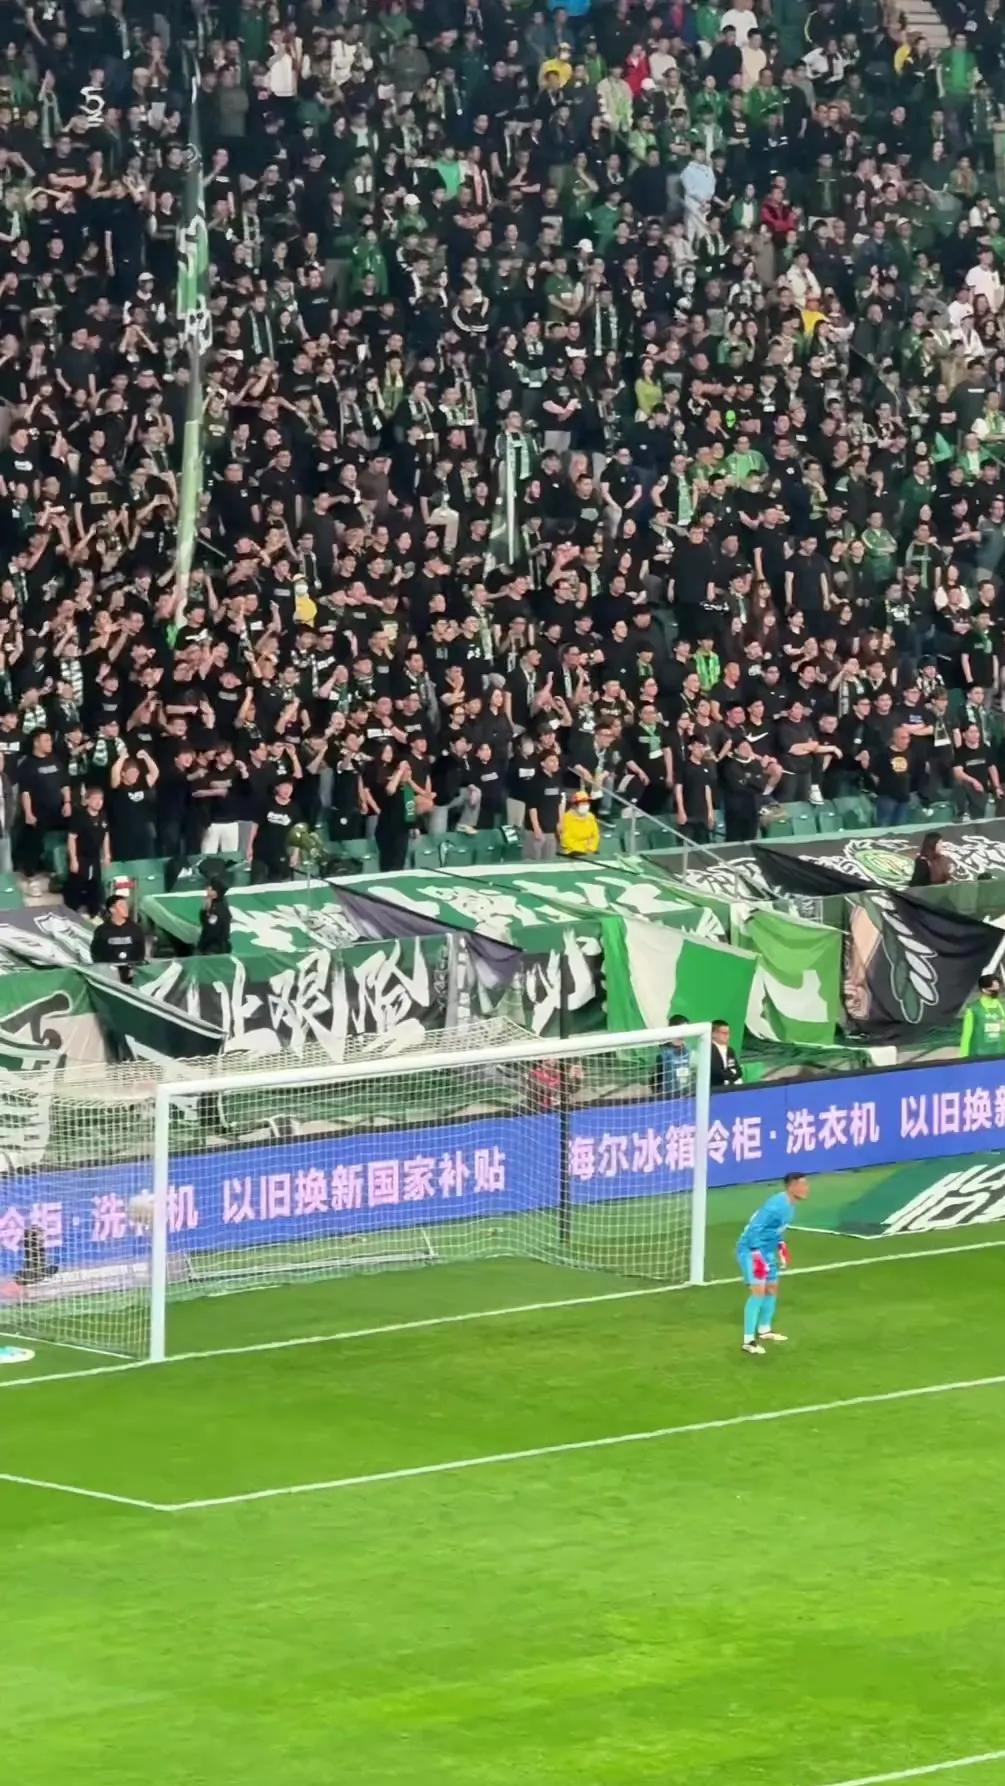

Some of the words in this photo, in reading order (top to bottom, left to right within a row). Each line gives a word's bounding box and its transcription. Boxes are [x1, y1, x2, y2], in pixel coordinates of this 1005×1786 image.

[222, 1146, 506, 1223] 以旧换新国家补贴
